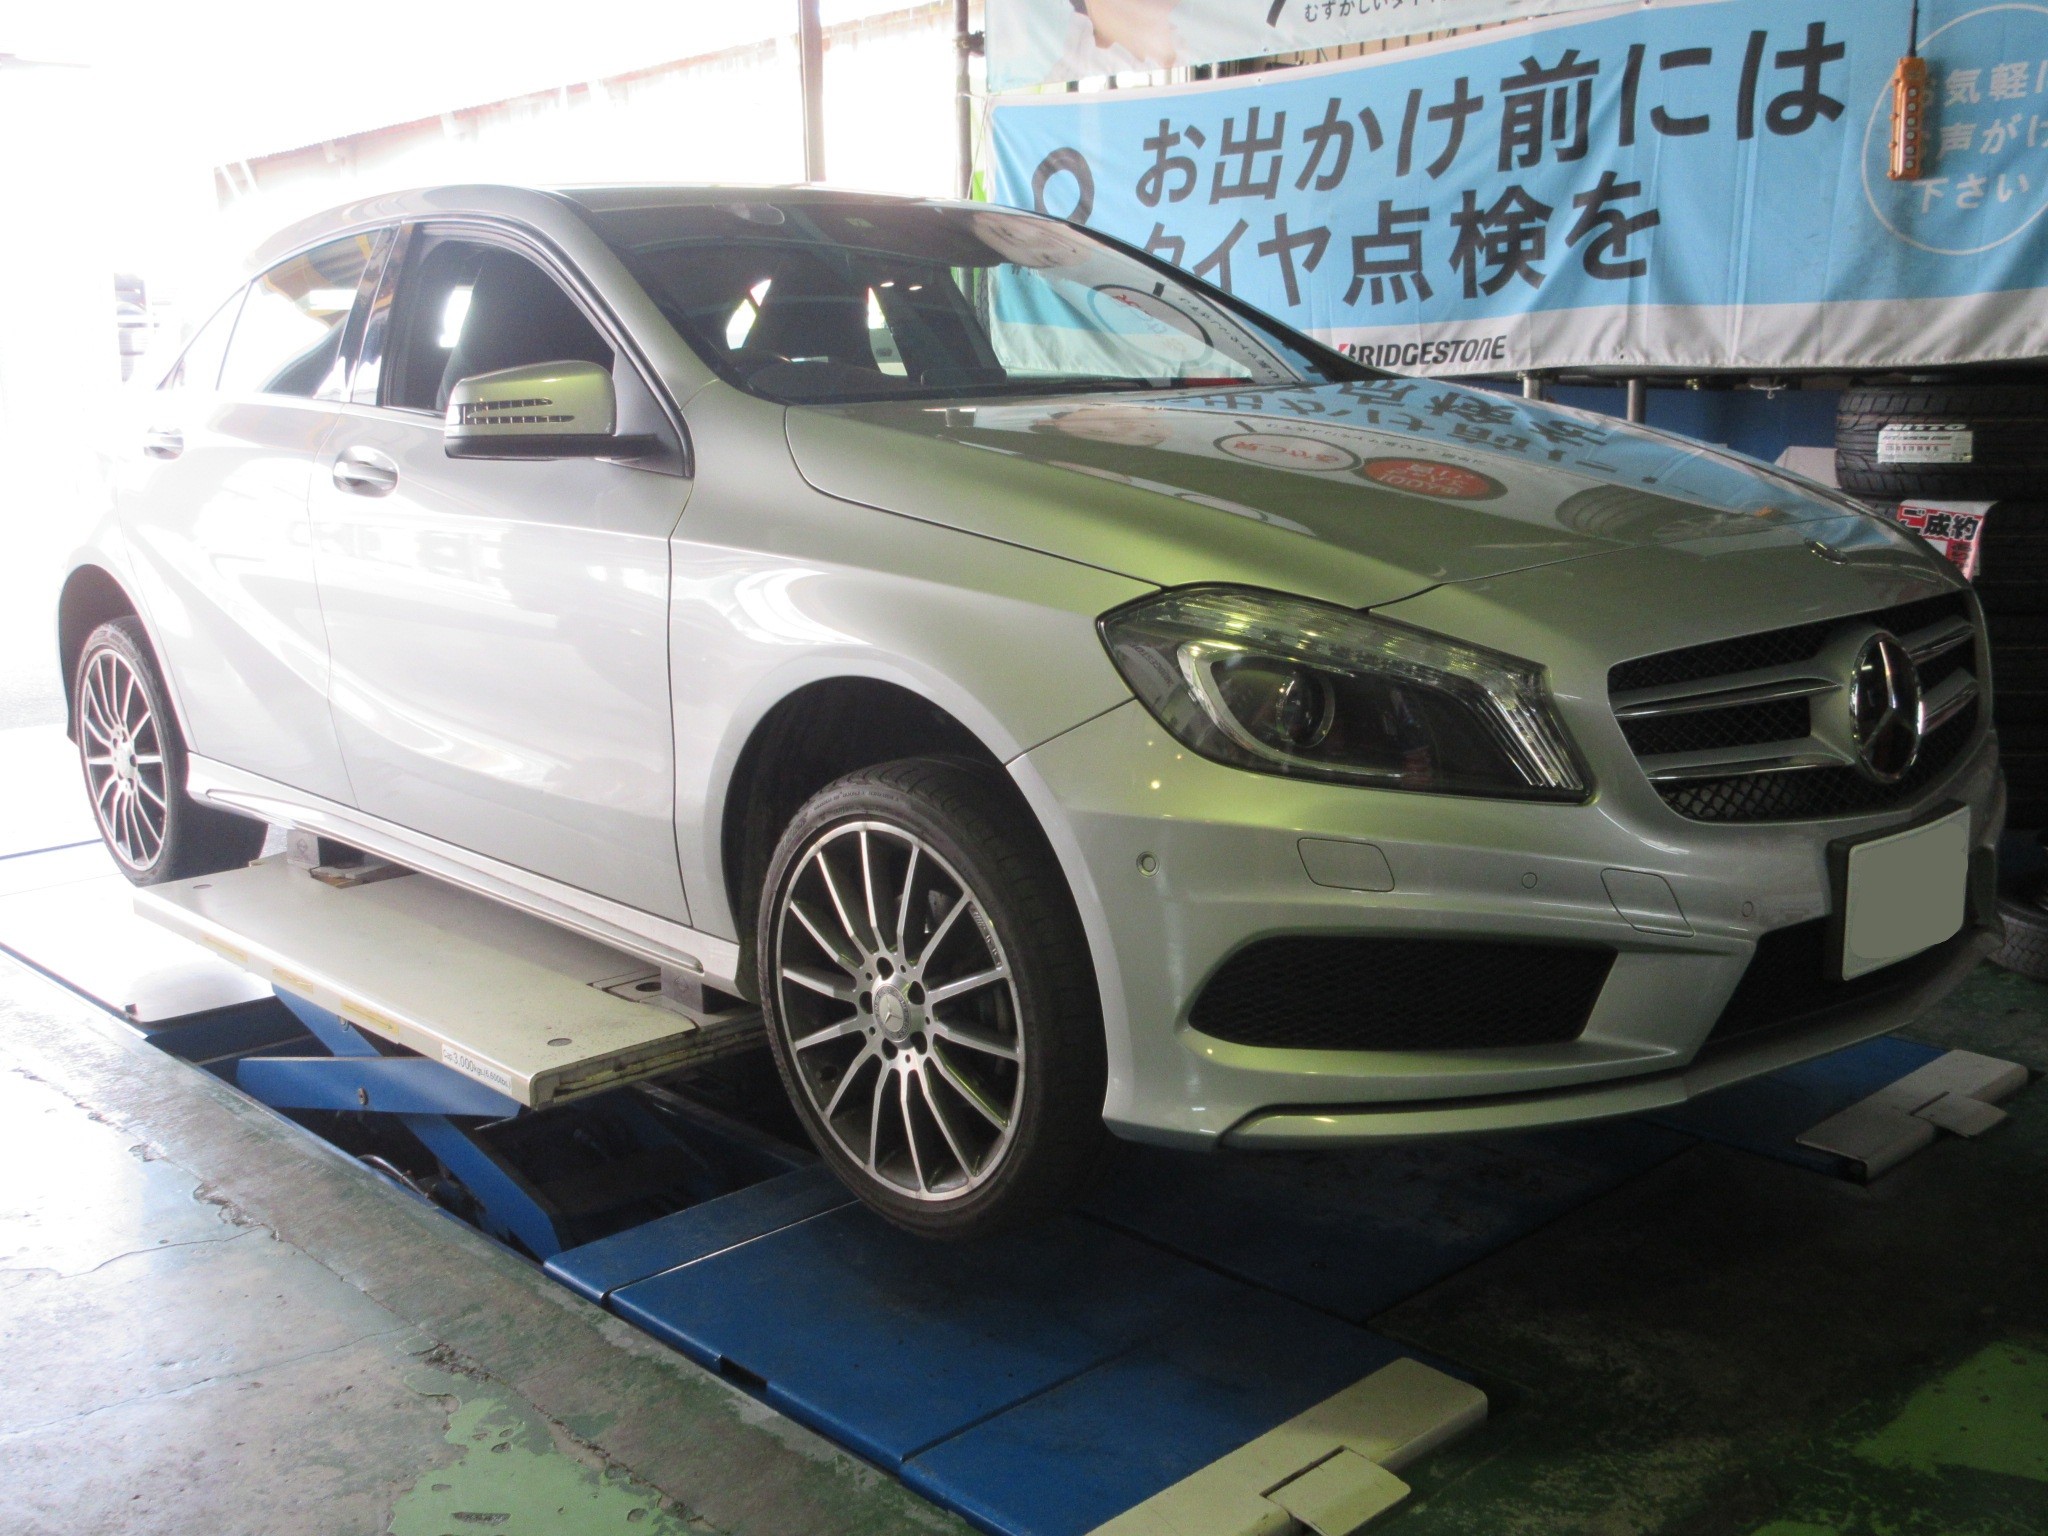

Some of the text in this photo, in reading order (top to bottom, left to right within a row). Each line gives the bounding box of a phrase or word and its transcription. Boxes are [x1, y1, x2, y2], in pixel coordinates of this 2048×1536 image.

[1135, 21, 1846, 208] お出かけ前には
[1911, 173, 2030, 214] 下さい
[1338, 335, 1508, 367] BRIDGESTONE
